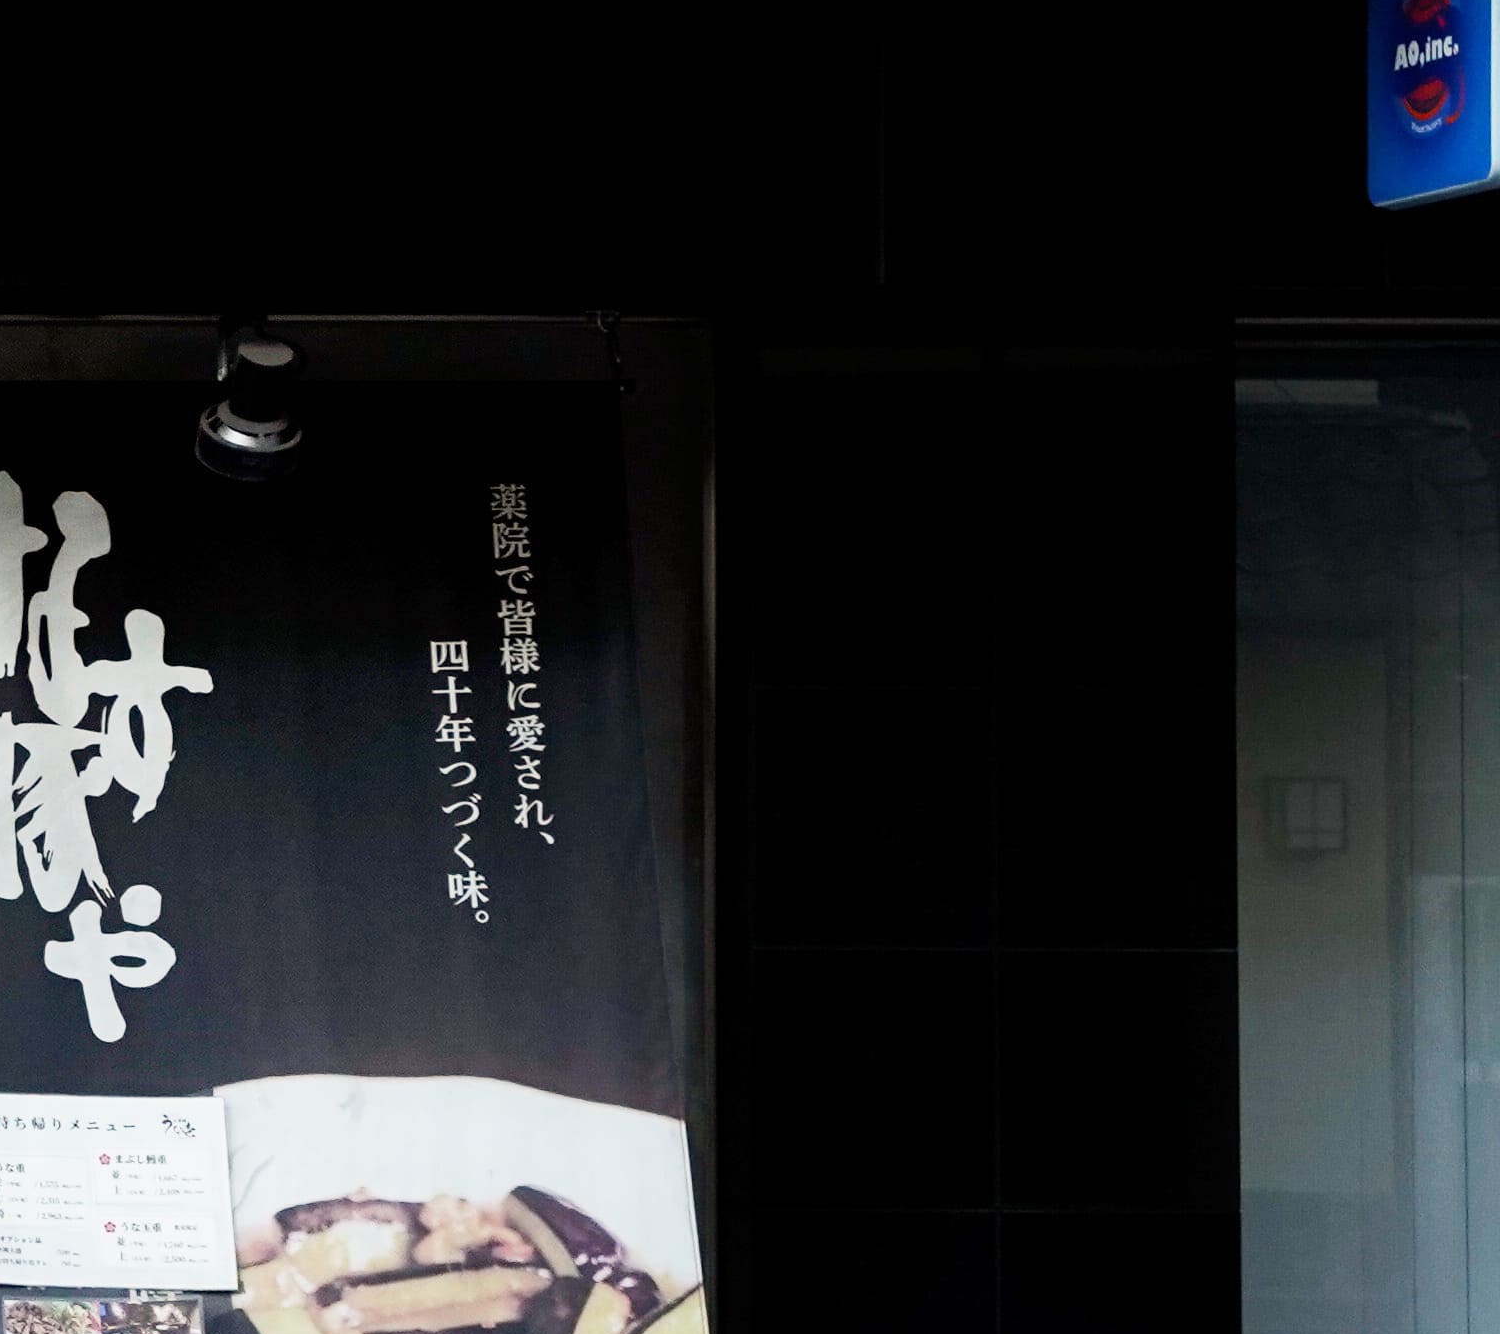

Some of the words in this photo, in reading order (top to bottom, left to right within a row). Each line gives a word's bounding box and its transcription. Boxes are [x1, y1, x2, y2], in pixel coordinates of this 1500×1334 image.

[429, 639, 492, 926] 四十年つづく味。
[490, 483, 556, 847] 薬院で皆様に愛され、
